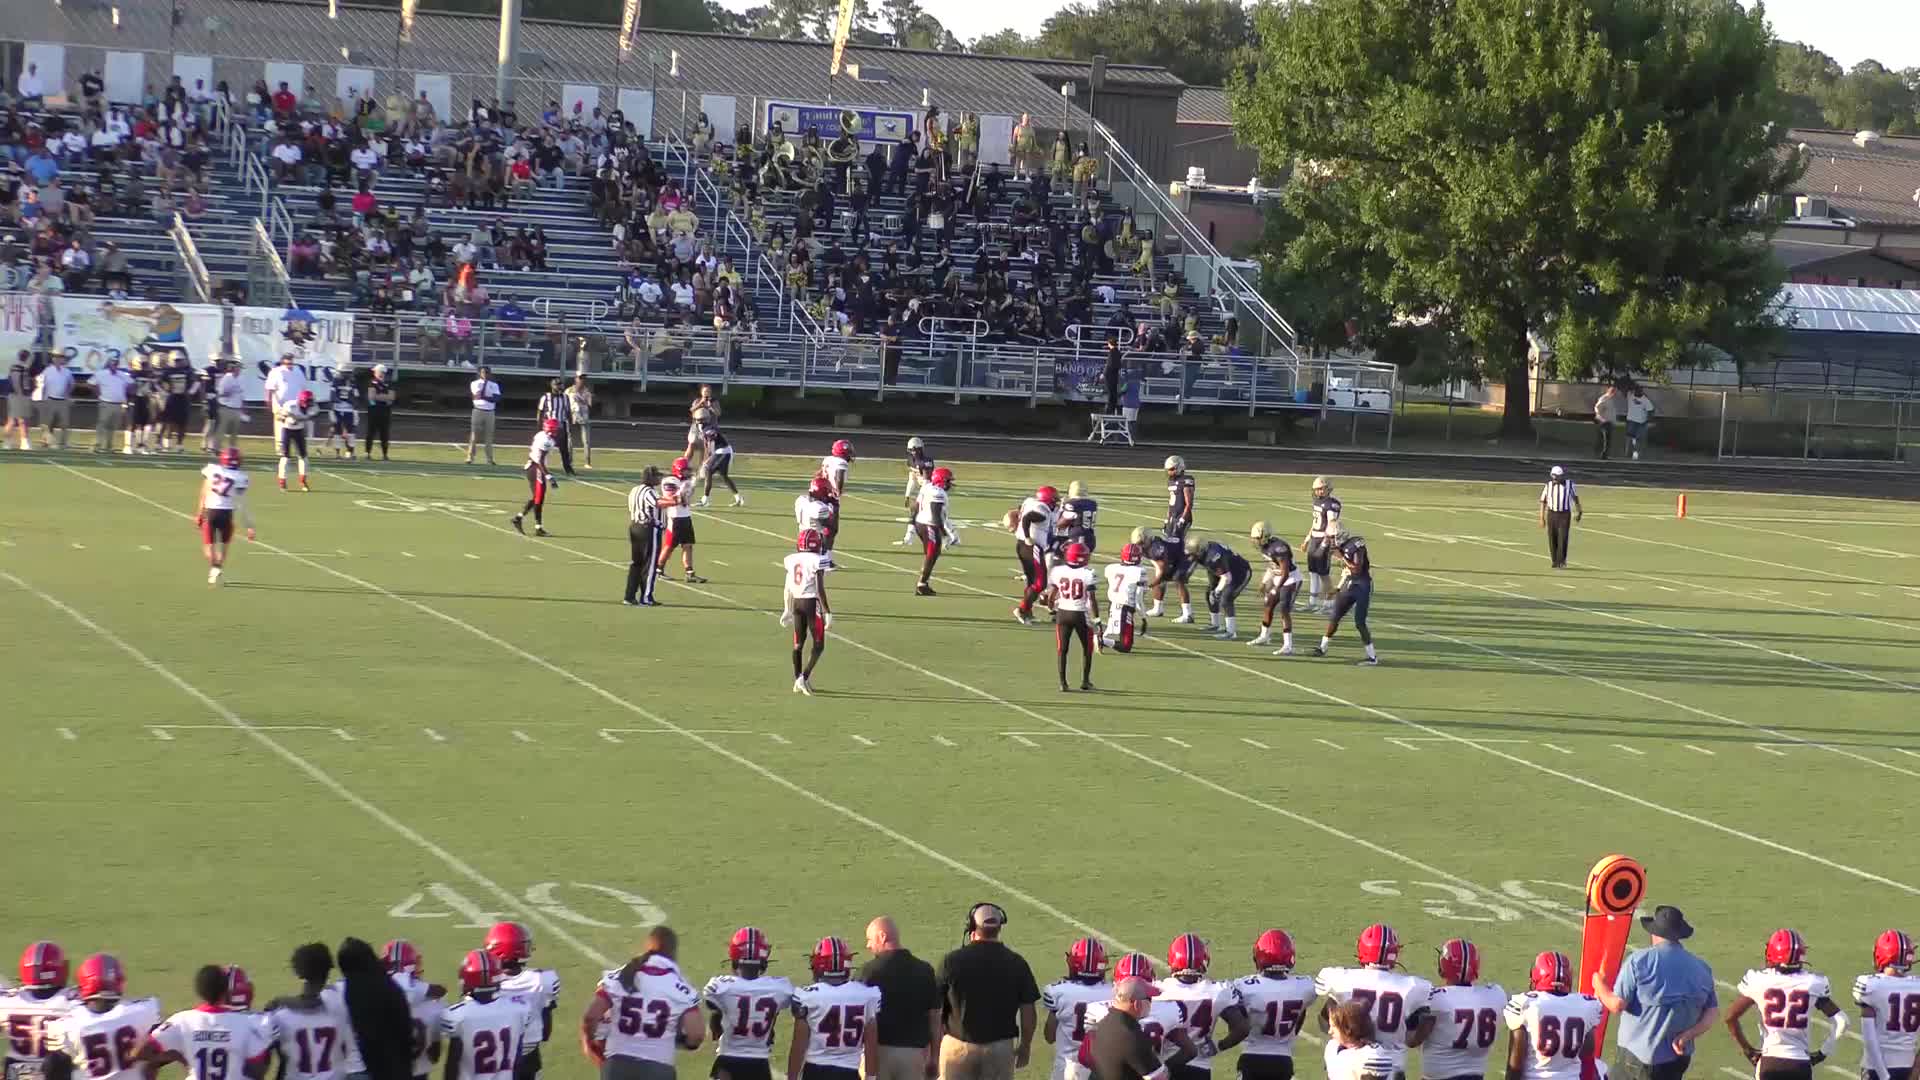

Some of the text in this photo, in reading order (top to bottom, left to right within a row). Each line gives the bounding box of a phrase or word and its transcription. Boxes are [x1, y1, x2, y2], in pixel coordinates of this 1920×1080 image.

[1055, 362, 1085, 377] BAND
[211, 472, 235, 497] 27
[793, 562, 803, 586] 6
[1059, 577, 1084, 600] 20
[1113, 573, 1125, 593] 7
[387, 882, 668, 929] 40
[618, 995, 671, 1039] 53
[733, 994, 779, 1038] 13
[817, 1004, 866, 1048] 45
[1263, 1000, 1303, 1037] 15
[1352, 988, 1404, 1033] 70
[1452, 1008, 1498, 1050] 76
[1763, 987, 1809, 1029] 22
[295, 1026, 336, 1074] 17
[473, 1026, 512, 1075] 21
[1538, 1015, 1585, 1059] 60
[195, 1047, 228, 1080] 19
